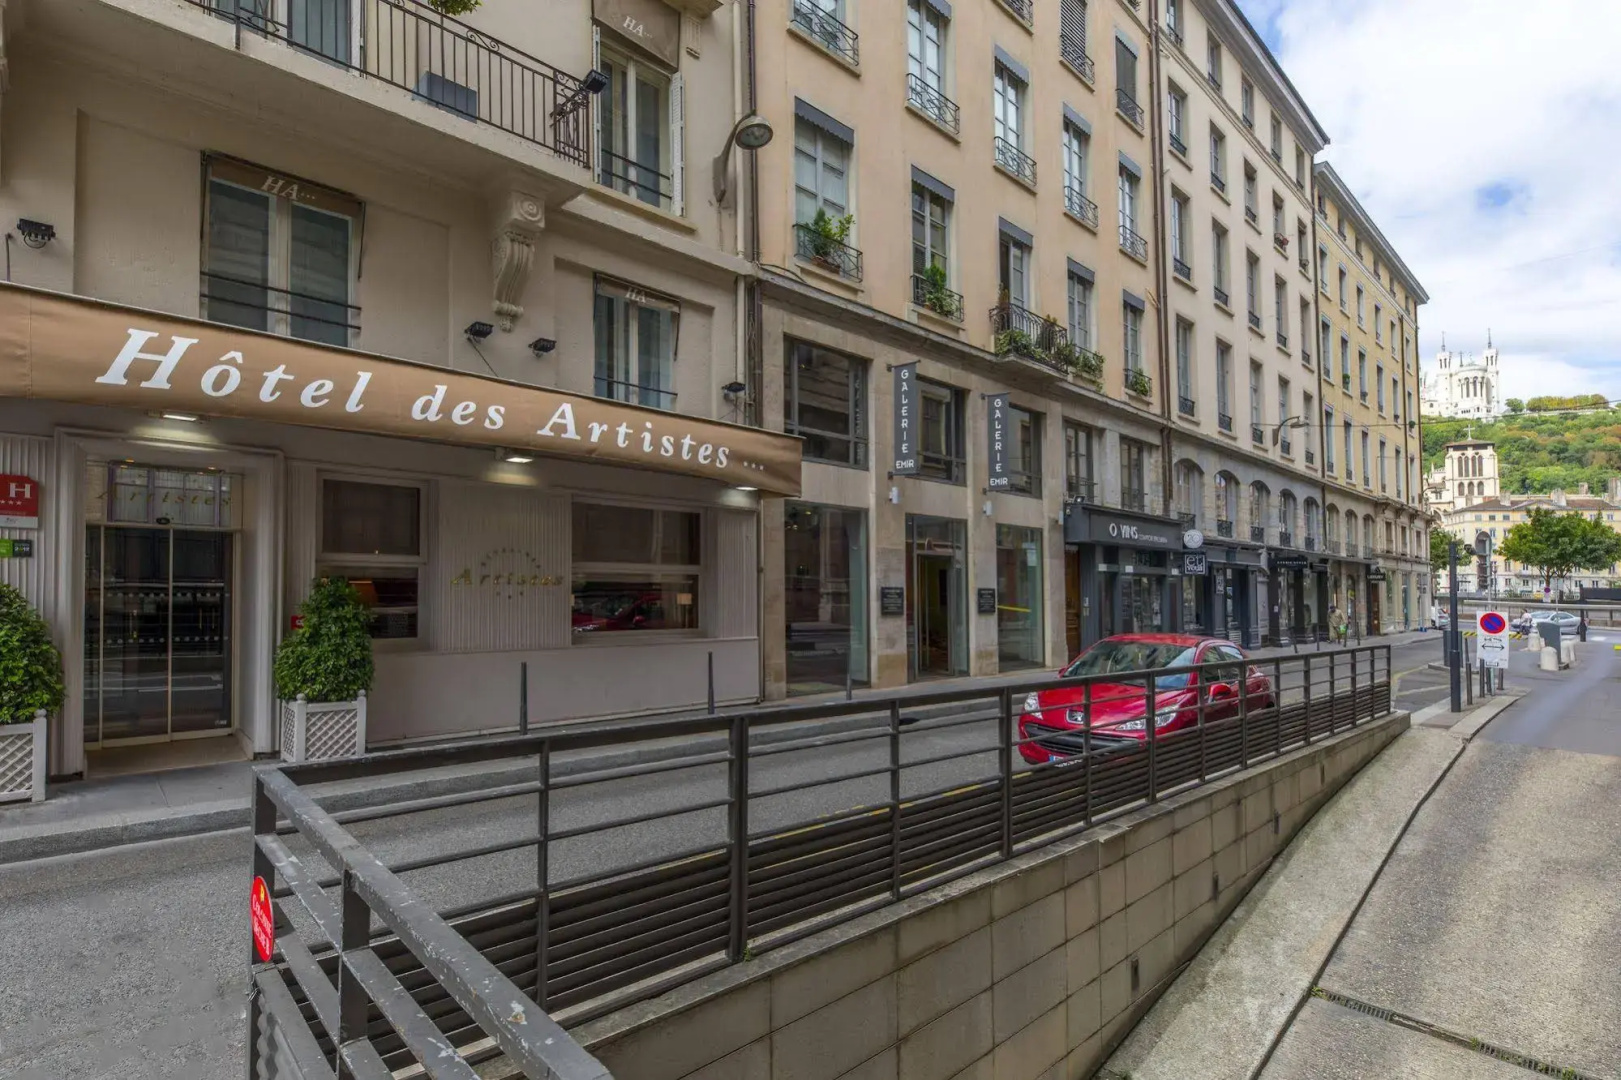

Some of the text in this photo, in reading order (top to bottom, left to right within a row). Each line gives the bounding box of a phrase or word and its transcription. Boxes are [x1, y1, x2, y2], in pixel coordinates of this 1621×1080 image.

[623, 16, 643, 37] HA
[260, 175, 299, 200] HA
[95, 328, 730, 468] Hôtel des Artistes
[994, 398, 1002, 473] GALERIE
[895, 460, 914, 469] EMIR
[990, 477, 1008, 486] EMIR
[1120, 524, 1138, 539] VINS
